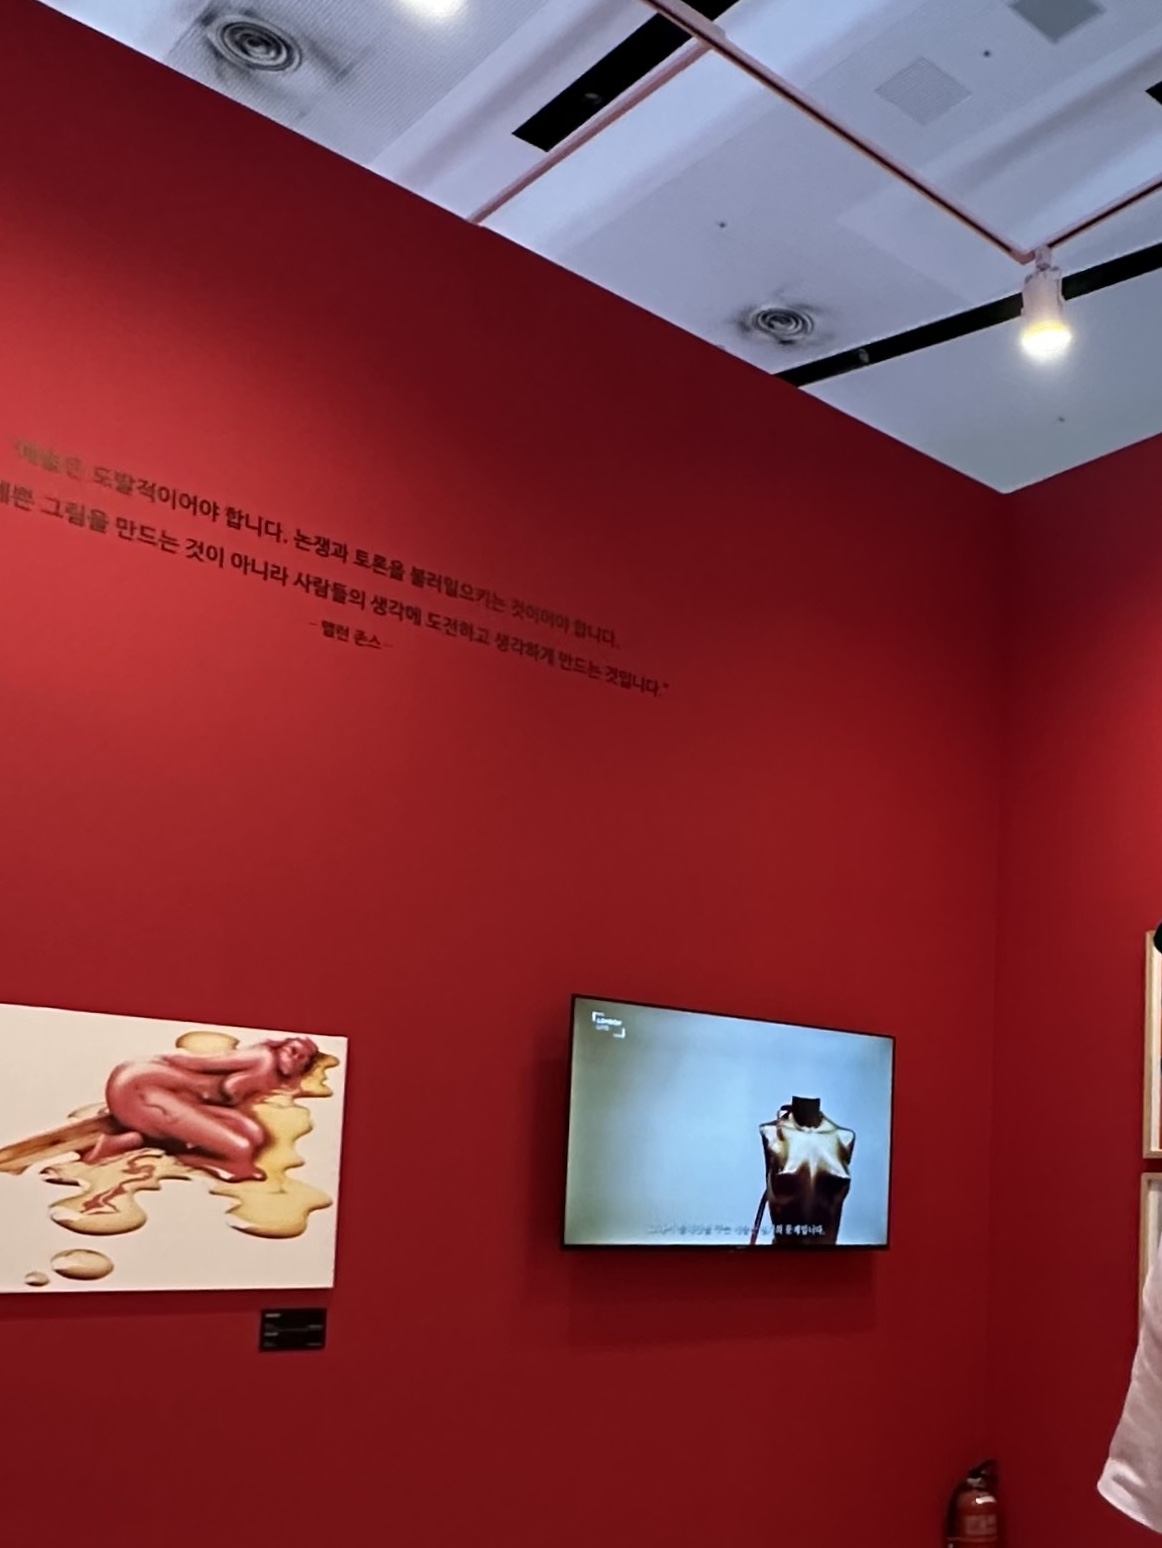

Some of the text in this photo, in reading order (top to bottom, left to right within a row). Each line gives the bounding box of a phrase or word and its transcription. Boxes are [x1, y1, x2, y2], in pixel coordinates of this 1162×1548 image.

[40, 496, 110, 534] 그림을
[116, 516, 180, 555] 만드는
[185, 537, 224, 569] 것이
[230, 552, 289, 587] 아니라
[293, 571, 366, 611] 사람들의
[370, 595, 422, 627] 생각에
[425, 612, 490, 646] 도전하고
[495, 632, 555, 667] 생각하게
[558, 650, 604, 680] 만드는
[94, 465, 219, 523] 도발적이어야
[225, 506, 287, 543] 합니다.
[294, 528, 348, 565] 논쟁과
[353, 548, 406, 582] 토론을
[410, 565, 506, 614] 불러일으키는
